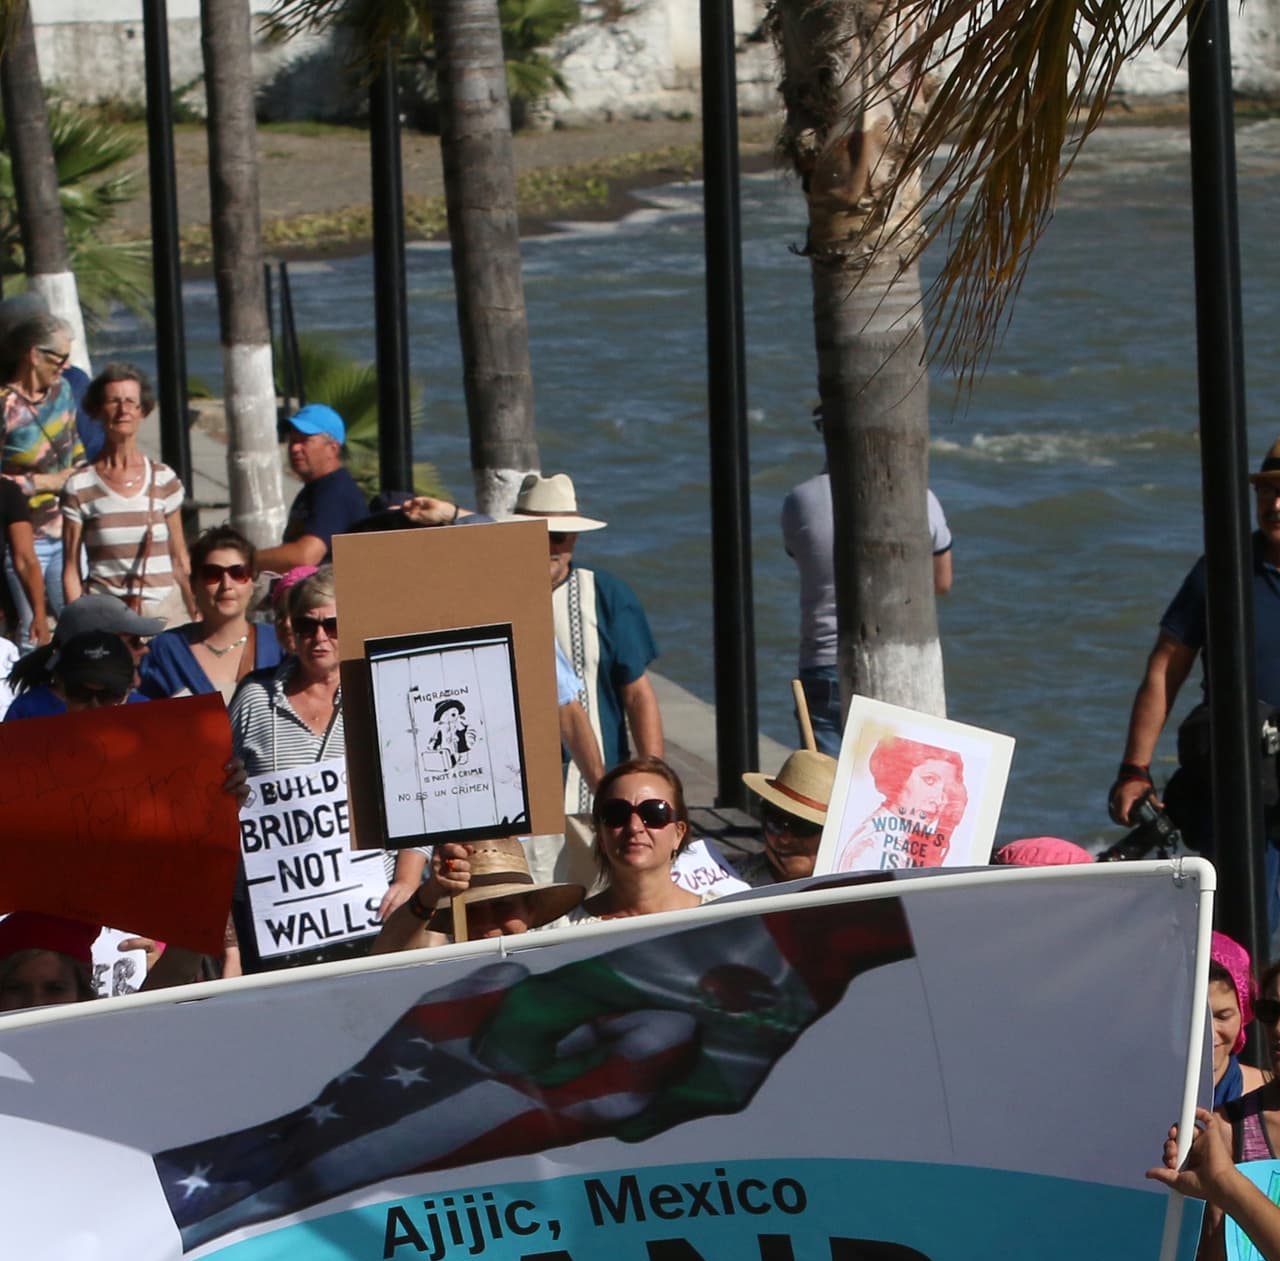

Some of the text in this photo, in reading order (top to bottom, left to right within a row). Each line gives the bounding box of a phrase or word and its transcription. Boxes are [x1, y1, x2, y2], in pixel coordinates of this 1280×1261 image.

[261, 770, 339, 805] BUILD
[432, 774, 450, 782] NOT
[458, 768, 484, 777] CRIME
[398, 793, 411, 802] NO
[415, 791, 428, 801] ES
[435, 789, 447, 798] UN
[240, 800, 350, 853] BRIDGE
[872, 816, 945, 847] WOMAN'S
[880, 851, 900, 870] IS
[883, 834, 928, 858] PLACE
[277, 848, 343, 893] NOT
[265, 897, 383, 948] WALLS
[382, 1167, 809, 1261] Ajijic, Mexico
